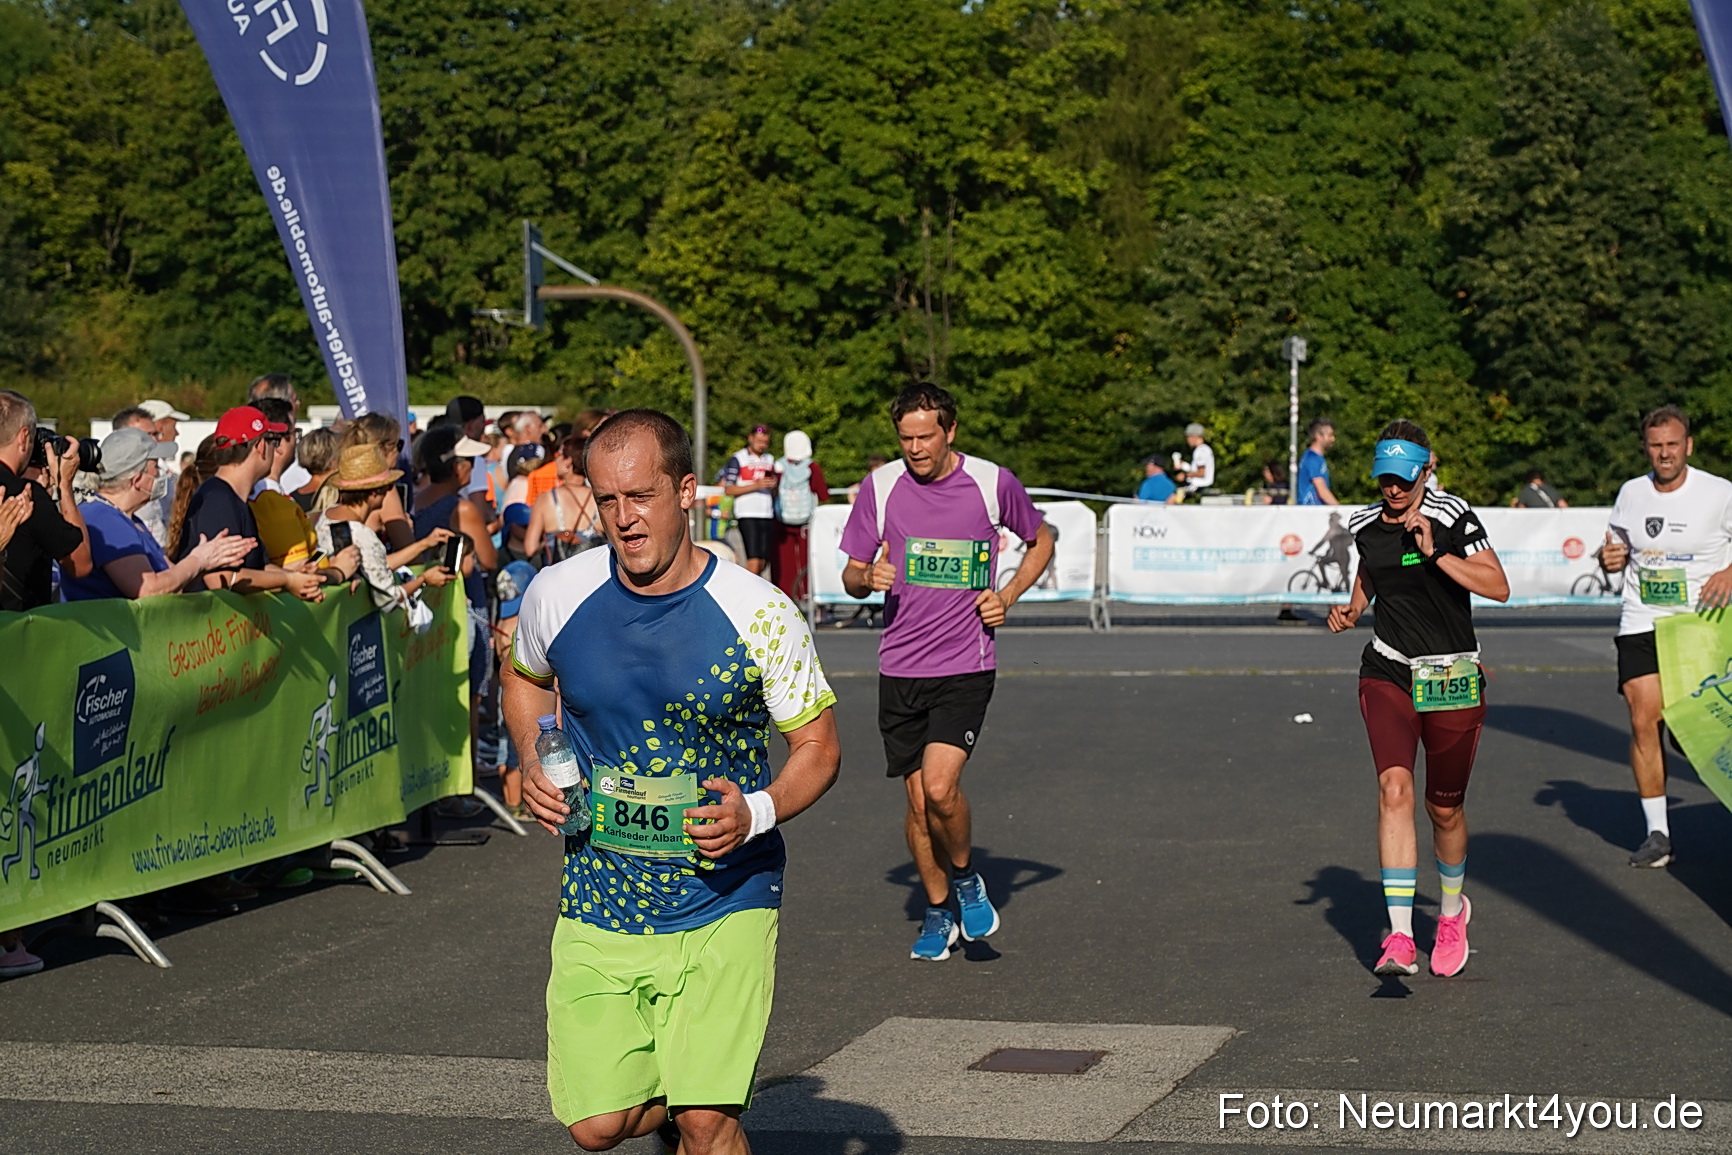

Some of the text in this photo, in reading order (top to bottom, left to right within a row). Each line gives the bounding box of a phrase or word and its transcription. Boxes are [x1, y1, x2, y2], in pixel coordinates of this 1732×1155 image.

[1132, 525, 1168, 539] NOW
[916, 555, 961, 573] 1873
[1645, 581, 1680, 595] 1225
[168, 611, 273, 678] Gesunde Firmen
[1424, 676, 1470, 697] 1159
[85, 688, 128, 717] Fischer
[46, 725, 177, 841] firmenlauf
[595, 802, 605, 832] RUN
[613, 799, 670, 832] 846
[46, 822, 105, 870] neumarkt
[131, 805, 278, 874] www.firmenlauf-oberpfalz.de
[604, 824, 683, 843] Karlseder Alban
